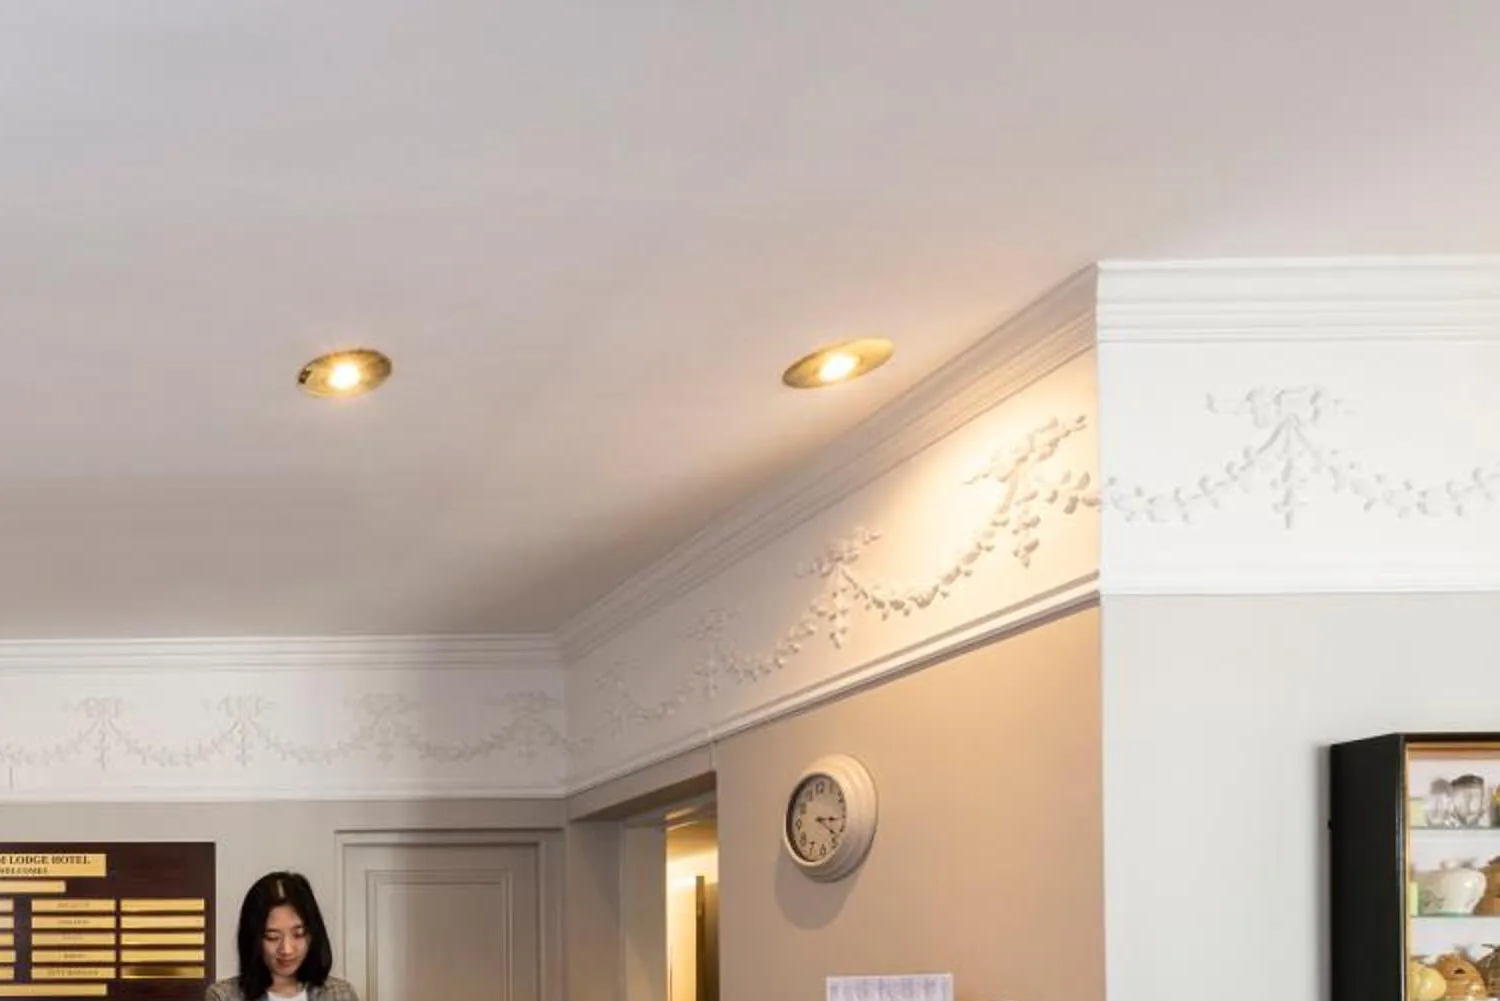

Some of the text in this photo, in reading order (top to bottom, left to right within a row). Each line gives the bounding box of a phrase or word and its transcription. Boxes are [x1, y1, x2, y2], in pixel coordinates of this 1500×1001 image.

[815, 781, 825, 793] 12
[795, 819, 802, 831] 9
[809, 841, 815, 855] 7
[819, 844, 826, 856] 6
[9, 855, 50, 865] LODGE
[51, 855, 91, 865] HOTEL
